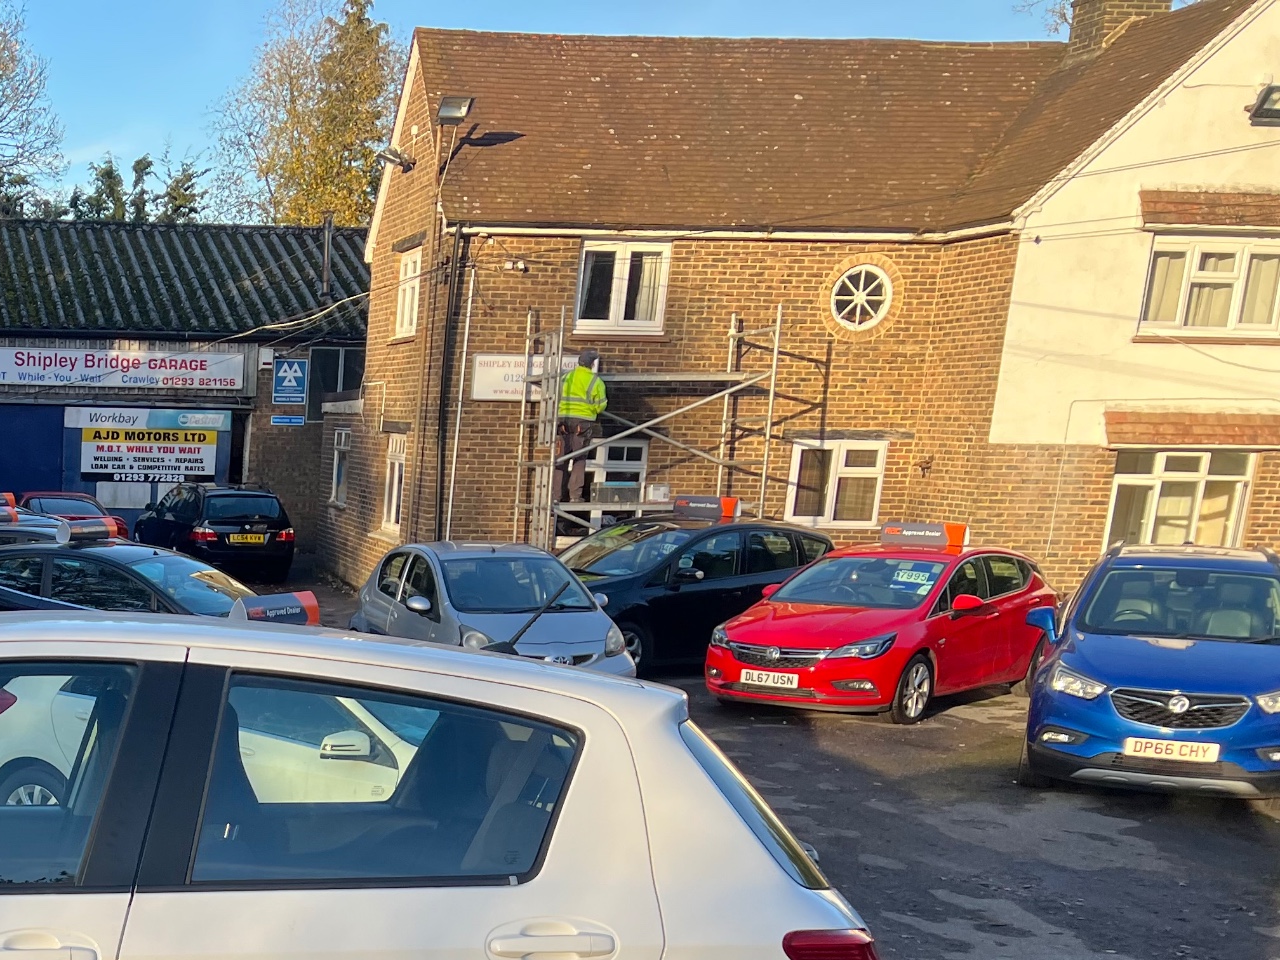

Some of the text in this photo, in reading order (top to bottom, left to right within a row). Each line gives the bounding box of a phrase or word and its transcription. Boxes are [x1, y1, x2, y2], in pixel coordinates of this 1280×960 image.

[14, 351, 208, 373] Shipley Bridge GARAGE
[18, 372, 45, 382] While
[53, 373, 71, 382] You
[80, 374, 102, 383] Wait
[121, 374, 160, 386] Crawley
[162, 377, 236, 387] 01293 821156
[88, 412, 138, 426] Workbay
[92, 430, 207, 443] AJD MOTORS LTD
[157, 446, 175, 454] YOU
[147, 474, 185, 483] 772828
[266, 607, 286, 618] Approved
[287, 606, 301, 615] Dealer
[745, 671, 794, 686] DL67 USN
[1133, 741, 1210, 758] DP66 CHY
